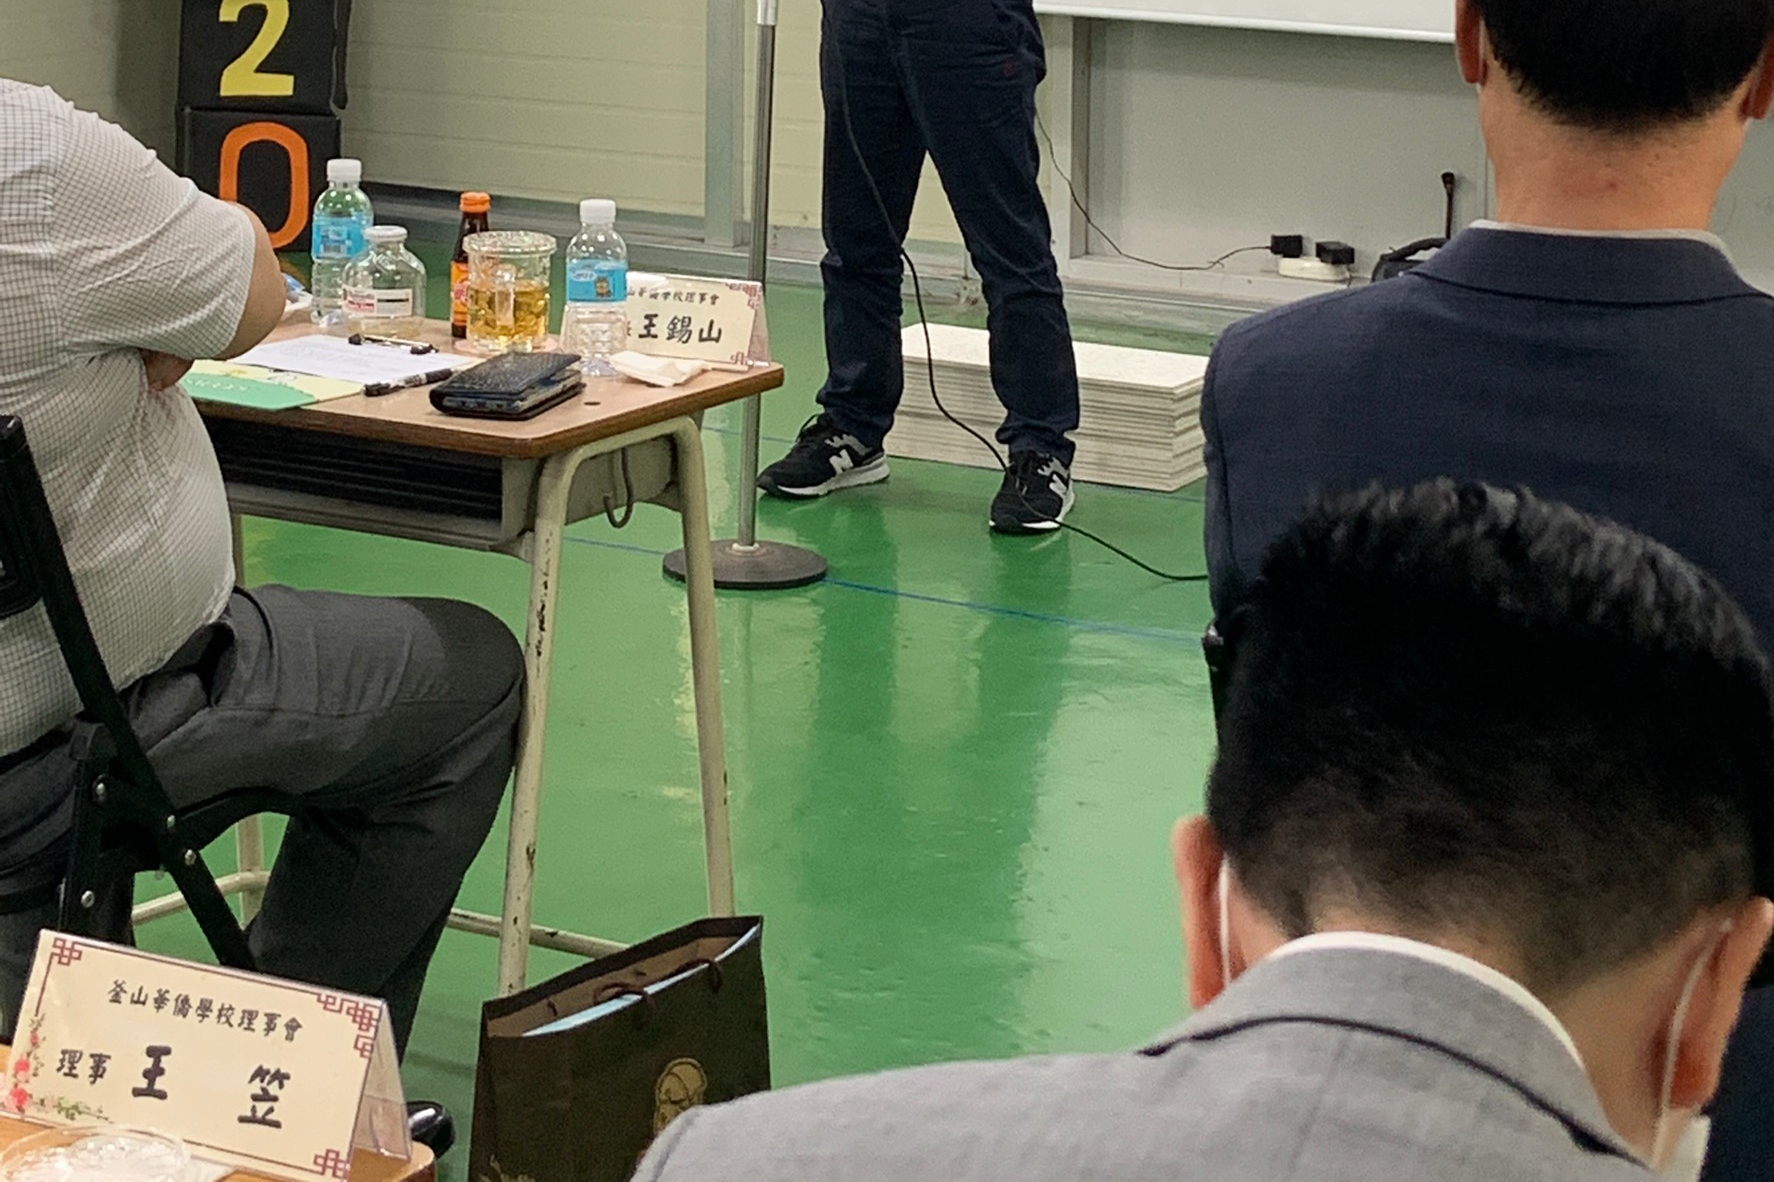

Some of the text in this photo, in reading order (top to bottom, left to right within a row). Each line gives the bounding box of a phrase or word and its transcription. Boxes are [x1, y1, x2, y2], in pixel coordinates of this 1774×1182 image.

[638, 313, 722, 344] 王錫山
[107, 980, 304, 1042] 釜山華僑學校理事會
[56, 1048, 112, 1085] 理事
